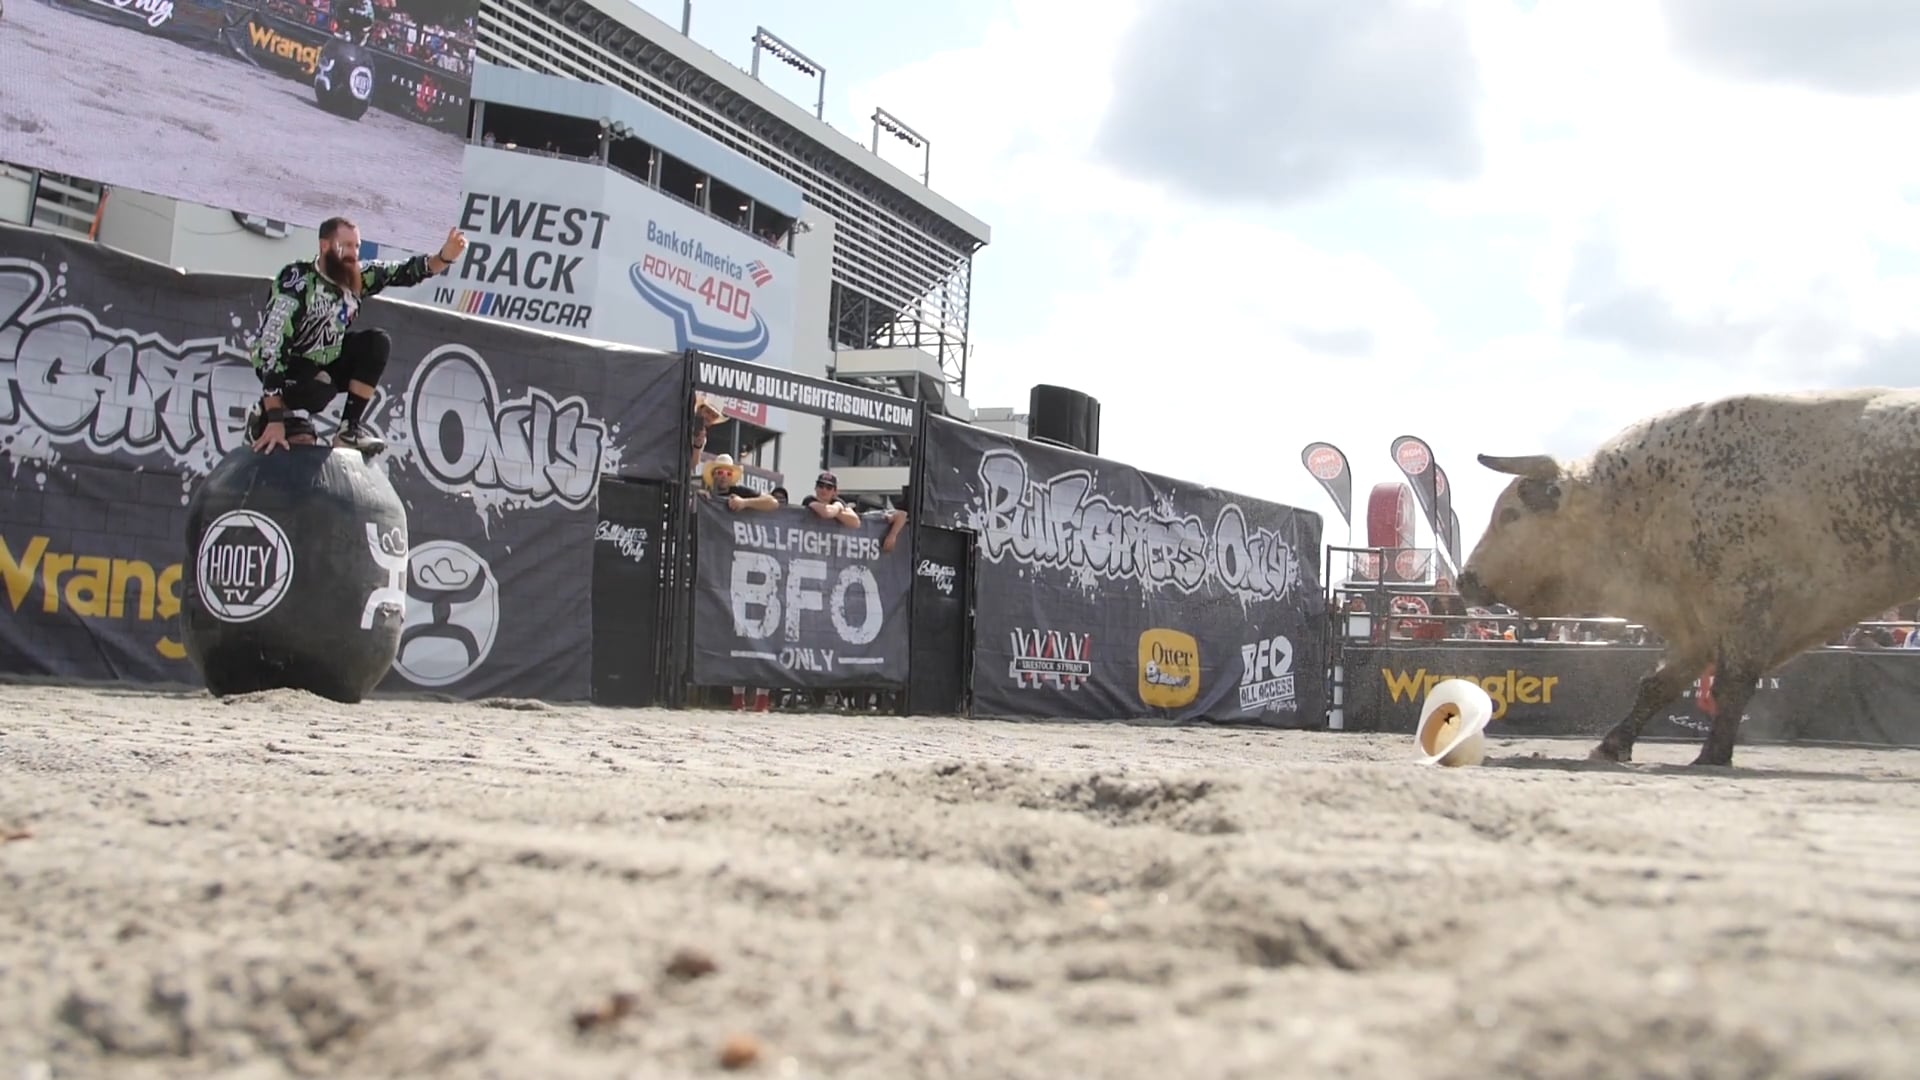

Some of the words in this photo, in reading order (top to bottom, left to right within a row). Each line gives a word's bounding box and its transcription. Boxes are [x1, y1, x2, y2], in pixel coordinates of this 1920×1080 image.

[459, 192, 610, 249] EWEST
[439, 241, 583, 294] RACK
[647, 219, 679, 253] Bank
[680, 238, 695, 258] of
[695, 242, 743, 281] America
[434, 287, 455, 304] IN
[490, 294, 592, 328] NASCAR
[643, 254, 697, 292] ROYAL
[698, 276, 750, 320] 400
[700, 362, 913, 427] WWW.BULLFIGHTERSONLY.COM
[210, 544, 272, 588] HOOEY
[733, 521, 880, 561] BULLFIGHTERS
[223, 589, 249, 602] TV
[731, 550, 883, 645] BFO
[779, 648, 835, 672] ONLY
[1241, 635, 1293, 686] BFO
[1241, 686, 1258, 705] ALL
[1258, 677, 1293, 700] ACCESS
[1381, 668, 1559, 720] Wrgler
